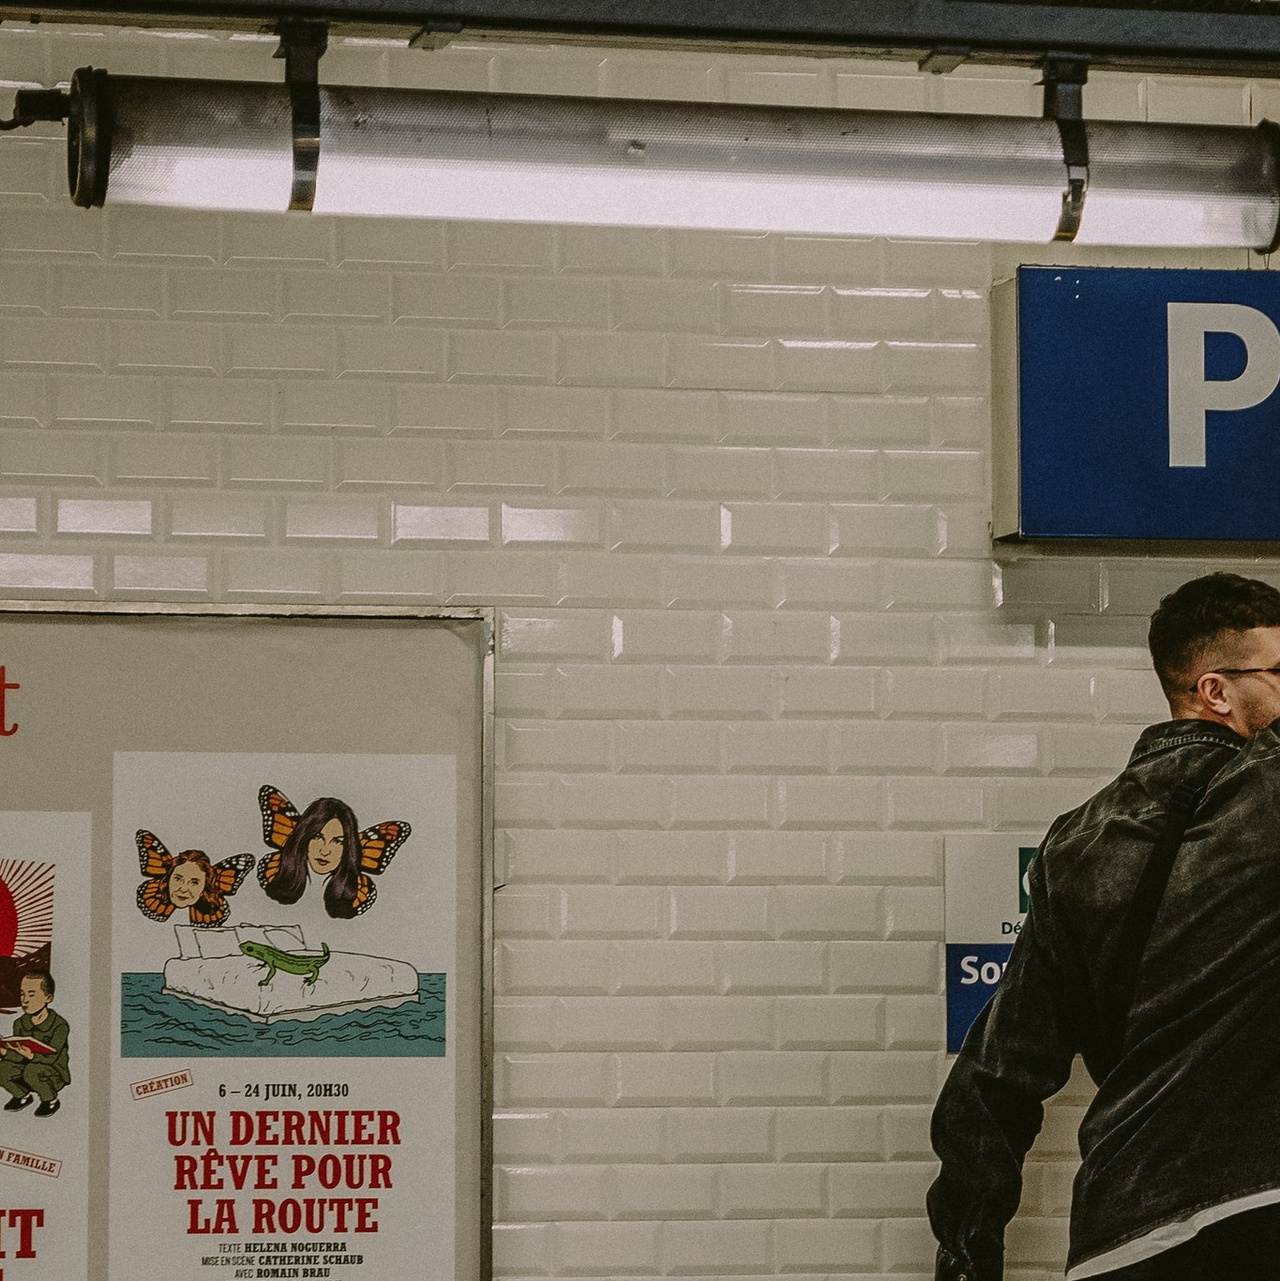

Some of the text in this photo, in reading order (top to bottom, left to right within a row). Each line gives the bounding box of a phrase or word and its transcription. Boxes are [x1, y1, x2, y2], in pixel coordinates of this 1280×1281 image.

[960, 955, 1008, 985] So
[218, 1083, 227, 1098] 6
[244, 1083, 261, 1098] 24
[263, 1083, 302, 1101] JUIN,
[306, 1083, 349, 1098] 20H30
[165, 1110, 402, 1147] UN DERNIER
[6, 1151, 56, 1173] FAMILLE
[173, 1147, 393, 1191] RÊVE POUR
[186, 1197, 379, 1235] LA ROUTE
[218, 1242, 347, 1254] TEXTE HELENA NOGUERRA
[201, 1255, 220, 1266] MISE
[220, 1255, 231, 1266] EN
[258, 1255, 320, 1266] CATHERINE
[322, 1254, 364, 1265] SCHAUB
[234, 1267, 331, 1279] AVEC ROMAIN BRAU
